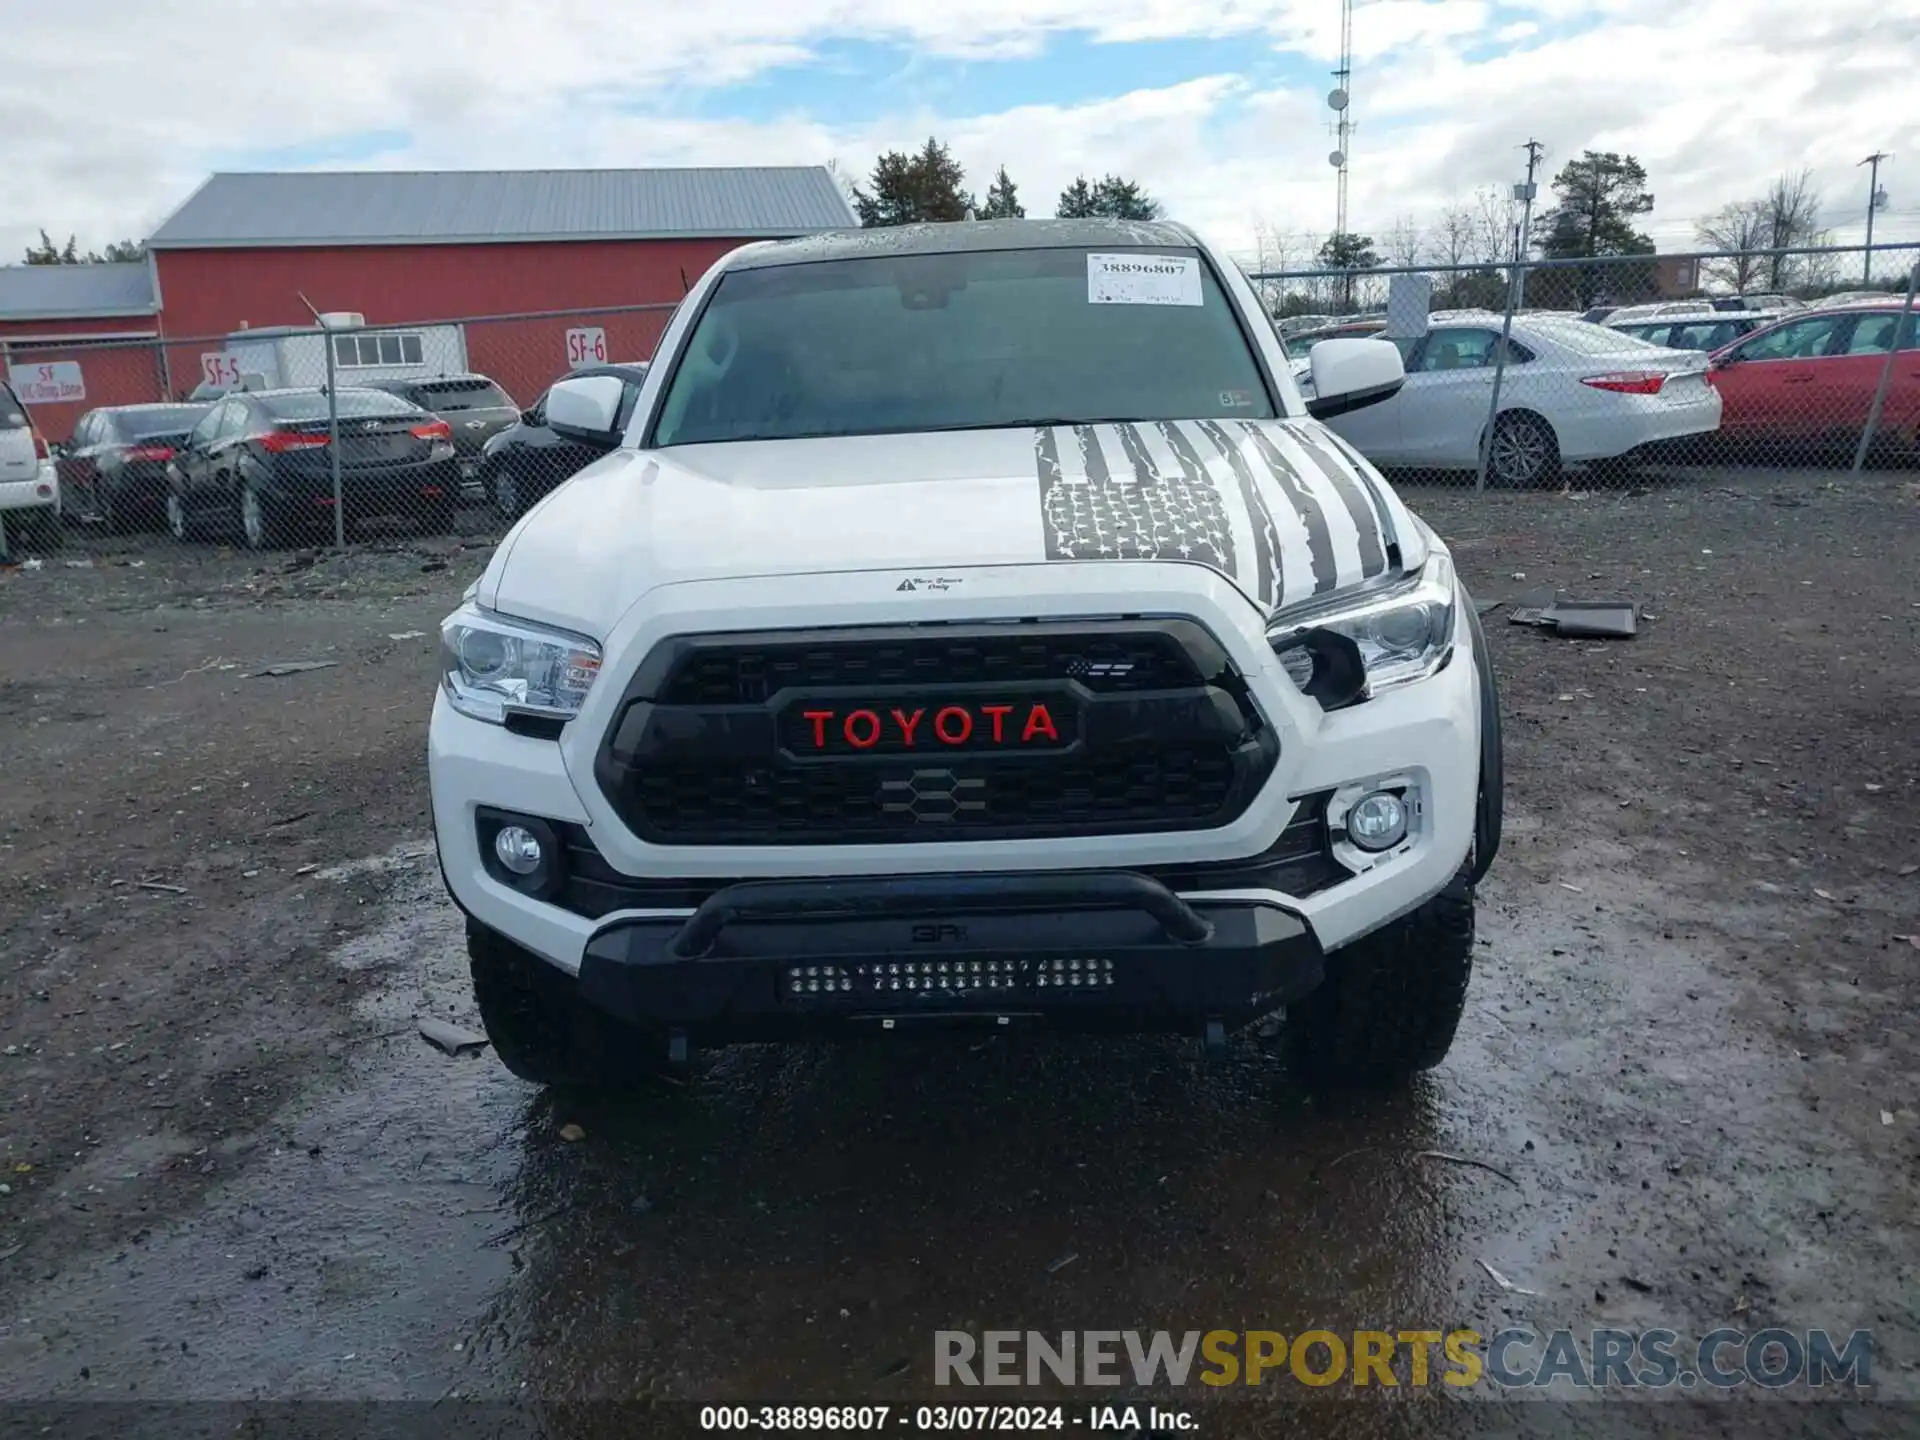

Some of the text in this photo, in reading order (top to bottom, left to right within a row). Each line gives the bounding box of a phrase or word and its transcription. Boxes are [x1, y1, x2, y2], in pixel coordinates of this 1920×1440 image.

[1101, 263, 1185, 275] 38896807
[570, 333, 604, 362] SF-6
[39, 365, 53, 381] SF
[206, 358, 239, 385] SF-5
[803, 703, 1058, 748] TOYOTA
